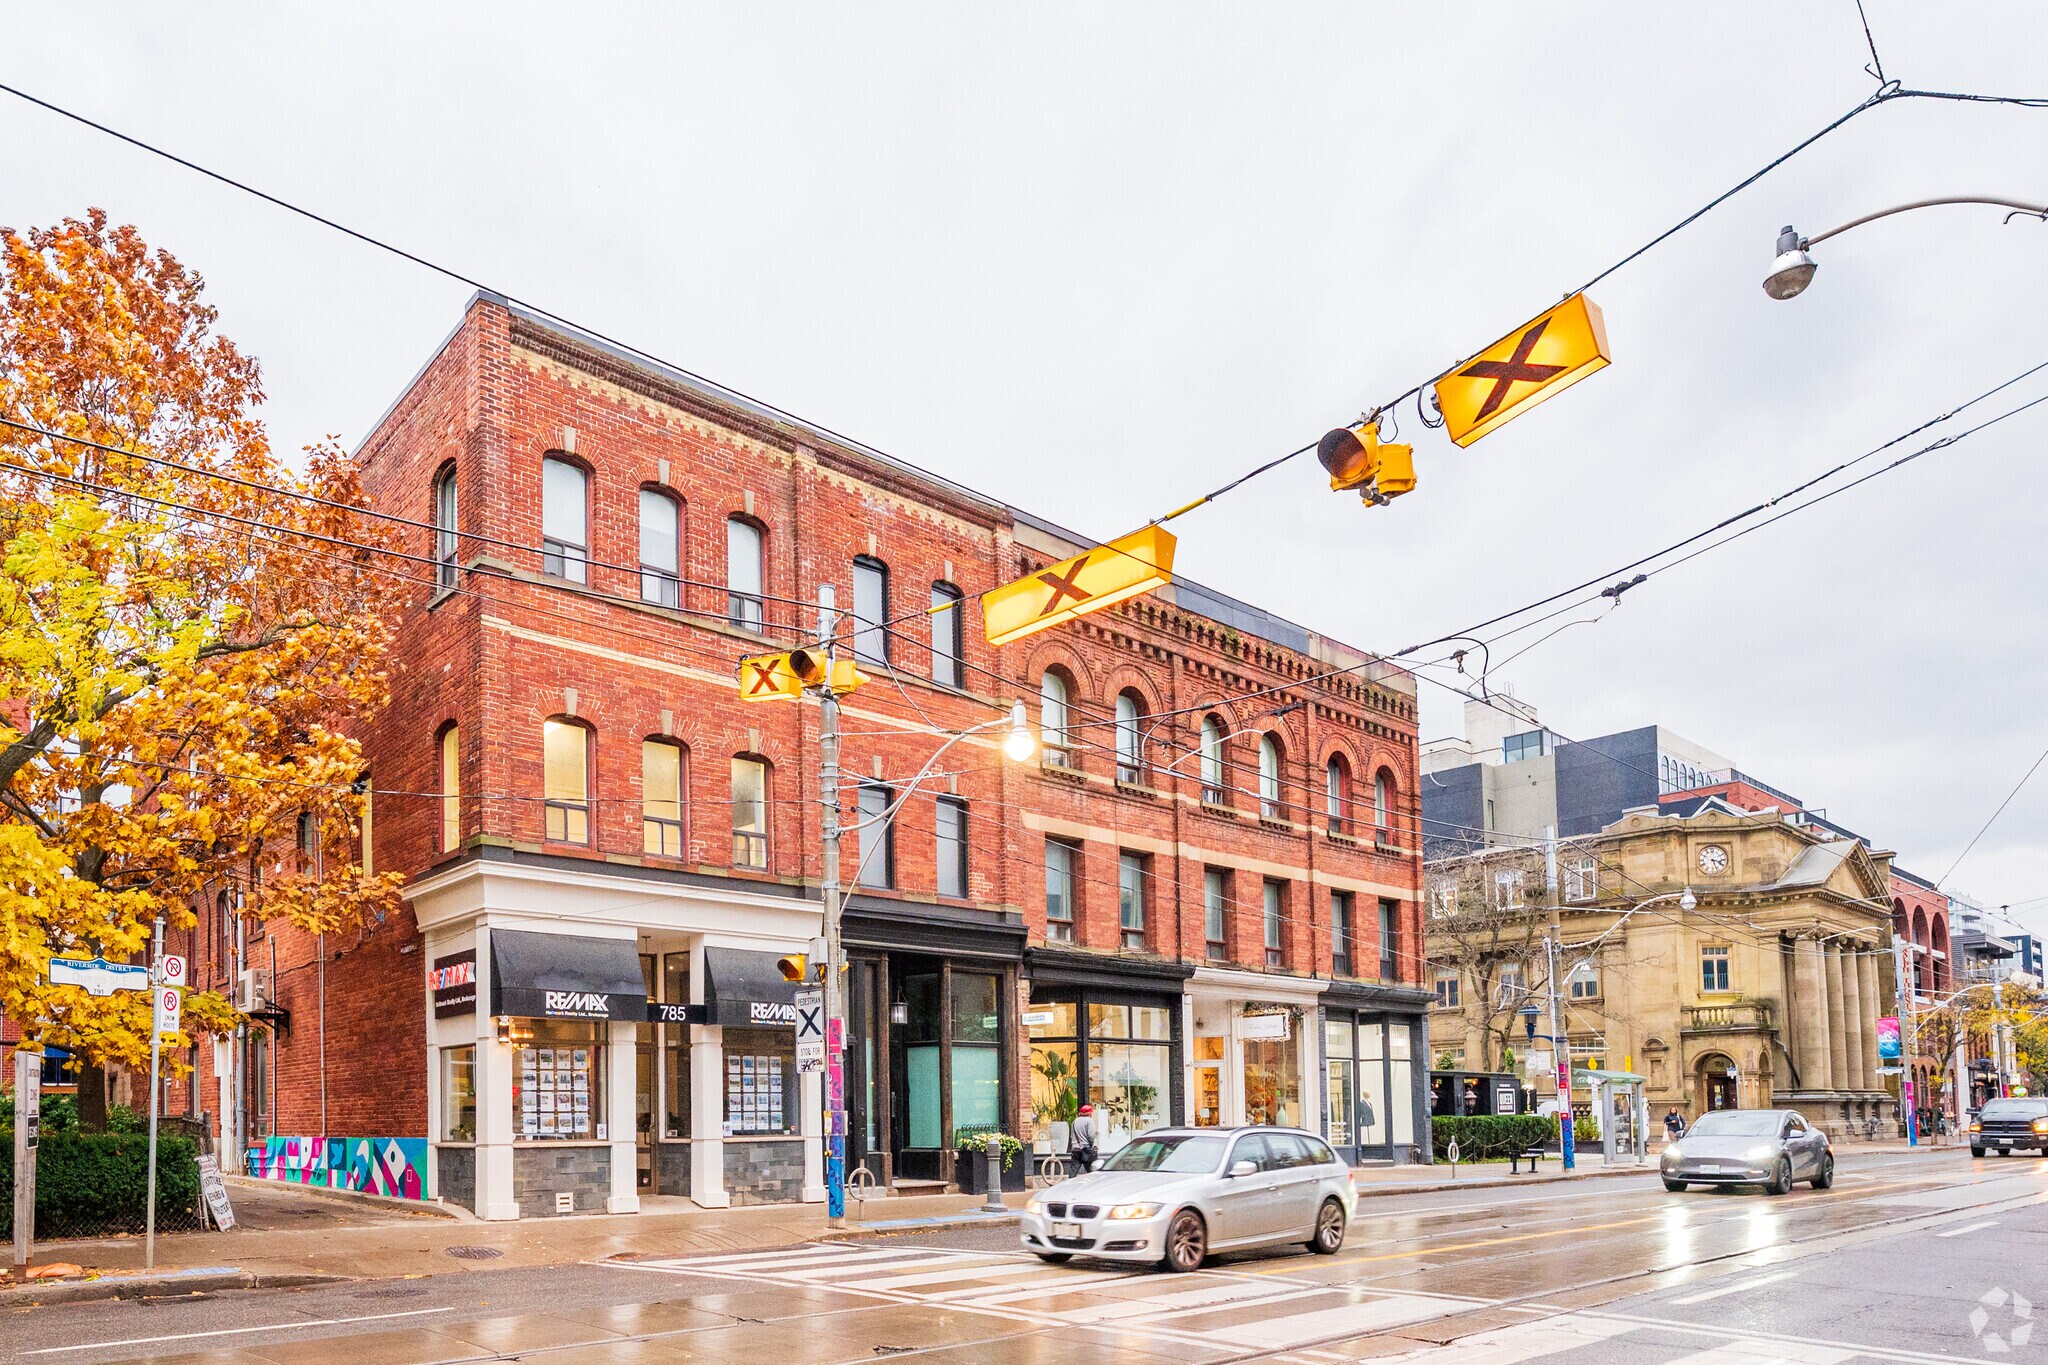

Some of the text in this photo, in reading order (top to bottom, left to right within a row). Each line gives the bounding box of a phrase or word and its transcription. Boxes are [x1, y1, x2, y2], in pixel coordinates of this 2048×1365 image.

[67, 961, 132, 973] RIVERSIDE DISTRICT
[73, 972, 106, 985] Queen
[122, 976, 129, 986] E
[428, 962, 475, 991] RE/MAX
[545, 991, 609, 1011] RE/MAX
[798, 996, 821, 1006] PEDESTRIAN
[659, 1005, 686, 1021] 785
[163, 1022, 176, 1030] ROUTE
[812, 1047, 820, 1055] FOR
